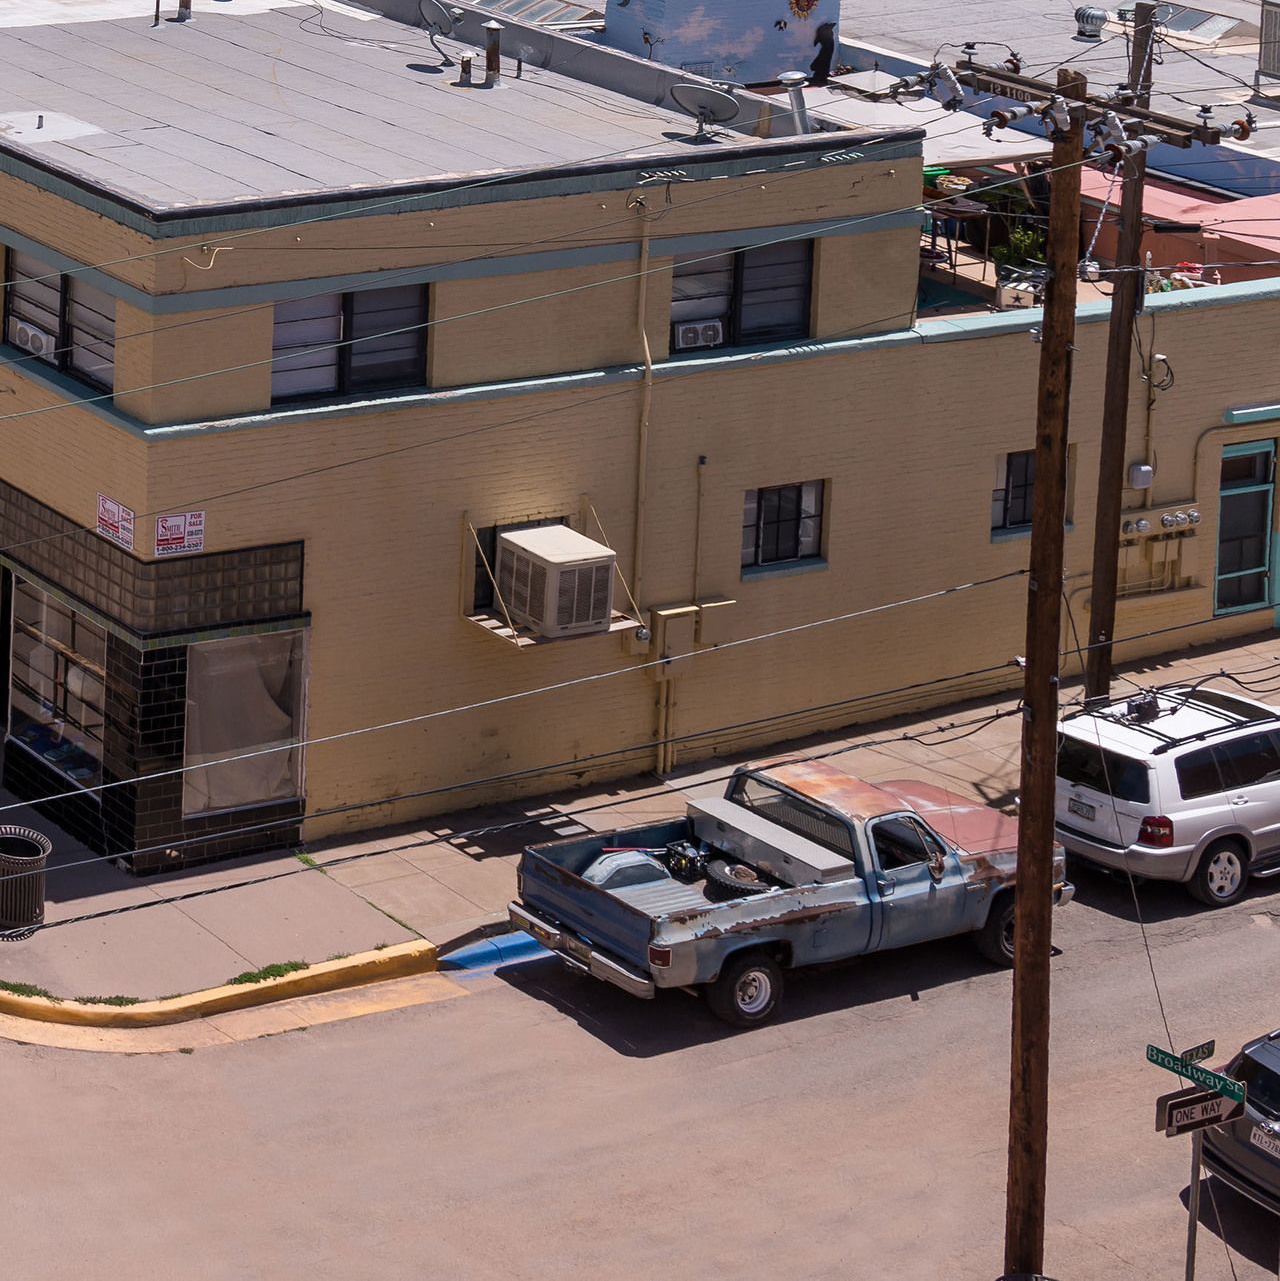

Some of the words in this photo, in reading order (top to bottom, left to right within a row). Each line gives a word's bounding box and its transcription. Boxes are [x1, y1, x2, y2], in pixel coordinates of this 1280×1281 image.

[190, 512, 202, 520] FOR
[160, 521, 181, 534] SMITH
[1182, 1046, 1209, 1066] TEXAS
[1147, 1046, 1224, 1092] Broadway
[1175, 1106, 1196, 1123] ONE
[1200, 1099, 1222, 1117] WAY
